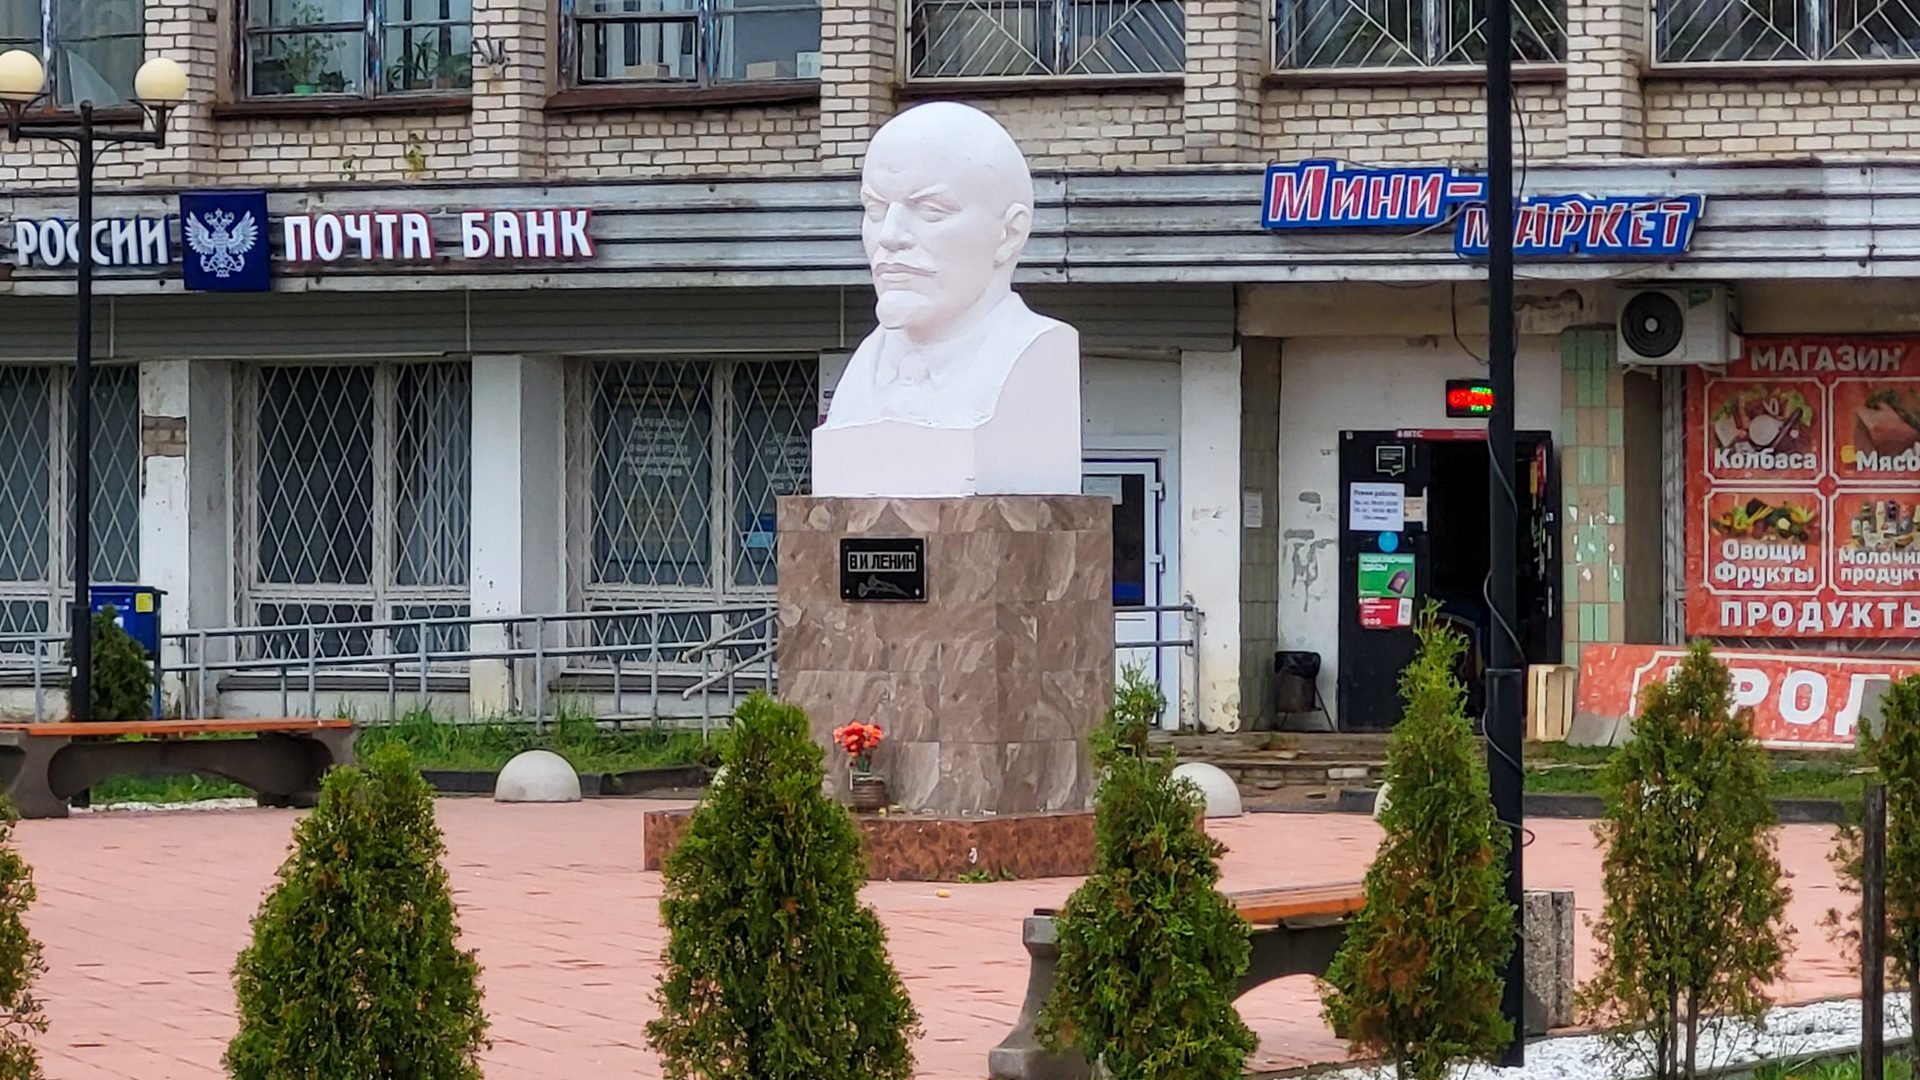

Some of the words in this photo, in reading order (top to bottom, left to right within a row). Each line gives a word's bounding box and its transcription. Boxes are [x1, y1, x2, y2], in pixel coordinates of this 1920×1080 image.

[15, 216, 171, 267] РОССИИ
[283, 210, 434, 262] ПОЧТА
[460, 207, 596, 260] БАНК
[1750, 345, 1903, 373] МАГАЗИН
[1714, 447, 1817, 470] Колбаса
[1856, 450, 1920, 472] Мясо
[871, 553, 915, 570] ЛЕНИН
[1721, 538, 1806, 563] Овощи
[1838, 549, 1920, 565] Молочн
[1714, 560, 1815, 588] Фрукты
